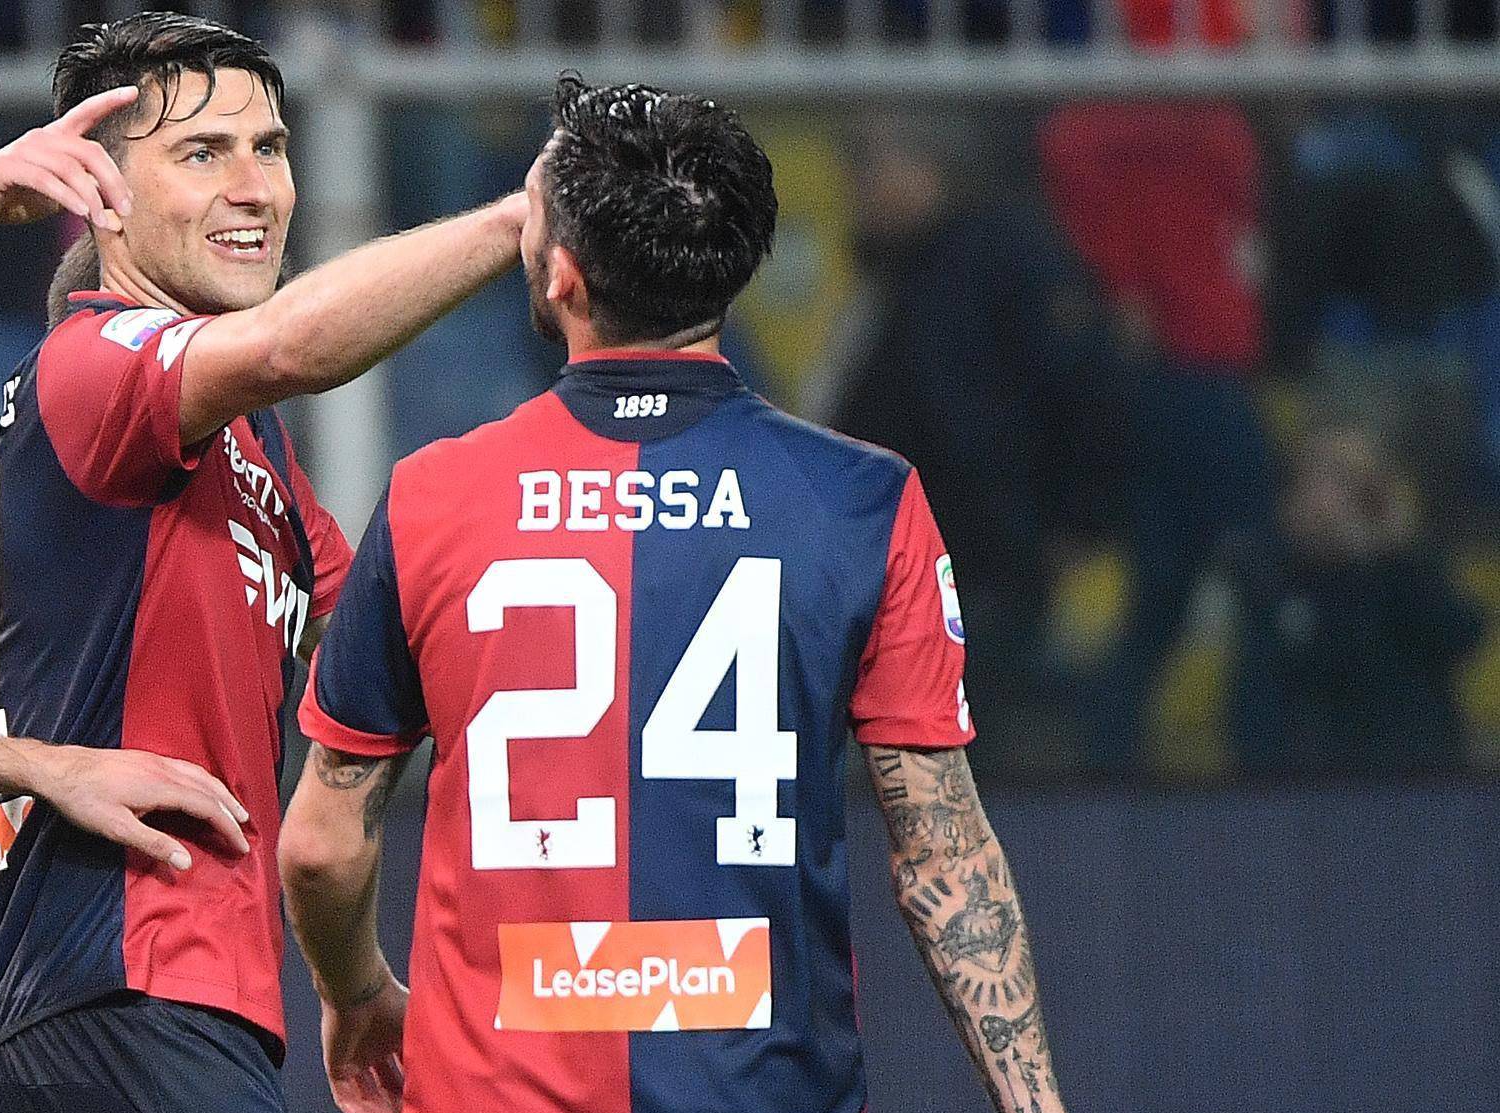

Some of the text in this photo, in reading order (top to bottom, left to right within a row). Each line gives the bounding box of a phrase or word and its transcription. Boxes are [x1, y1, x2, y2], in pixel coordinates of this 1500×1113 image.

[613, 393, 669, 419] 1893
[516, 468, 751, 532] BESSA
[466, 556, 798, 870] 24
[533, 956, 736, 998] LeasePlan
